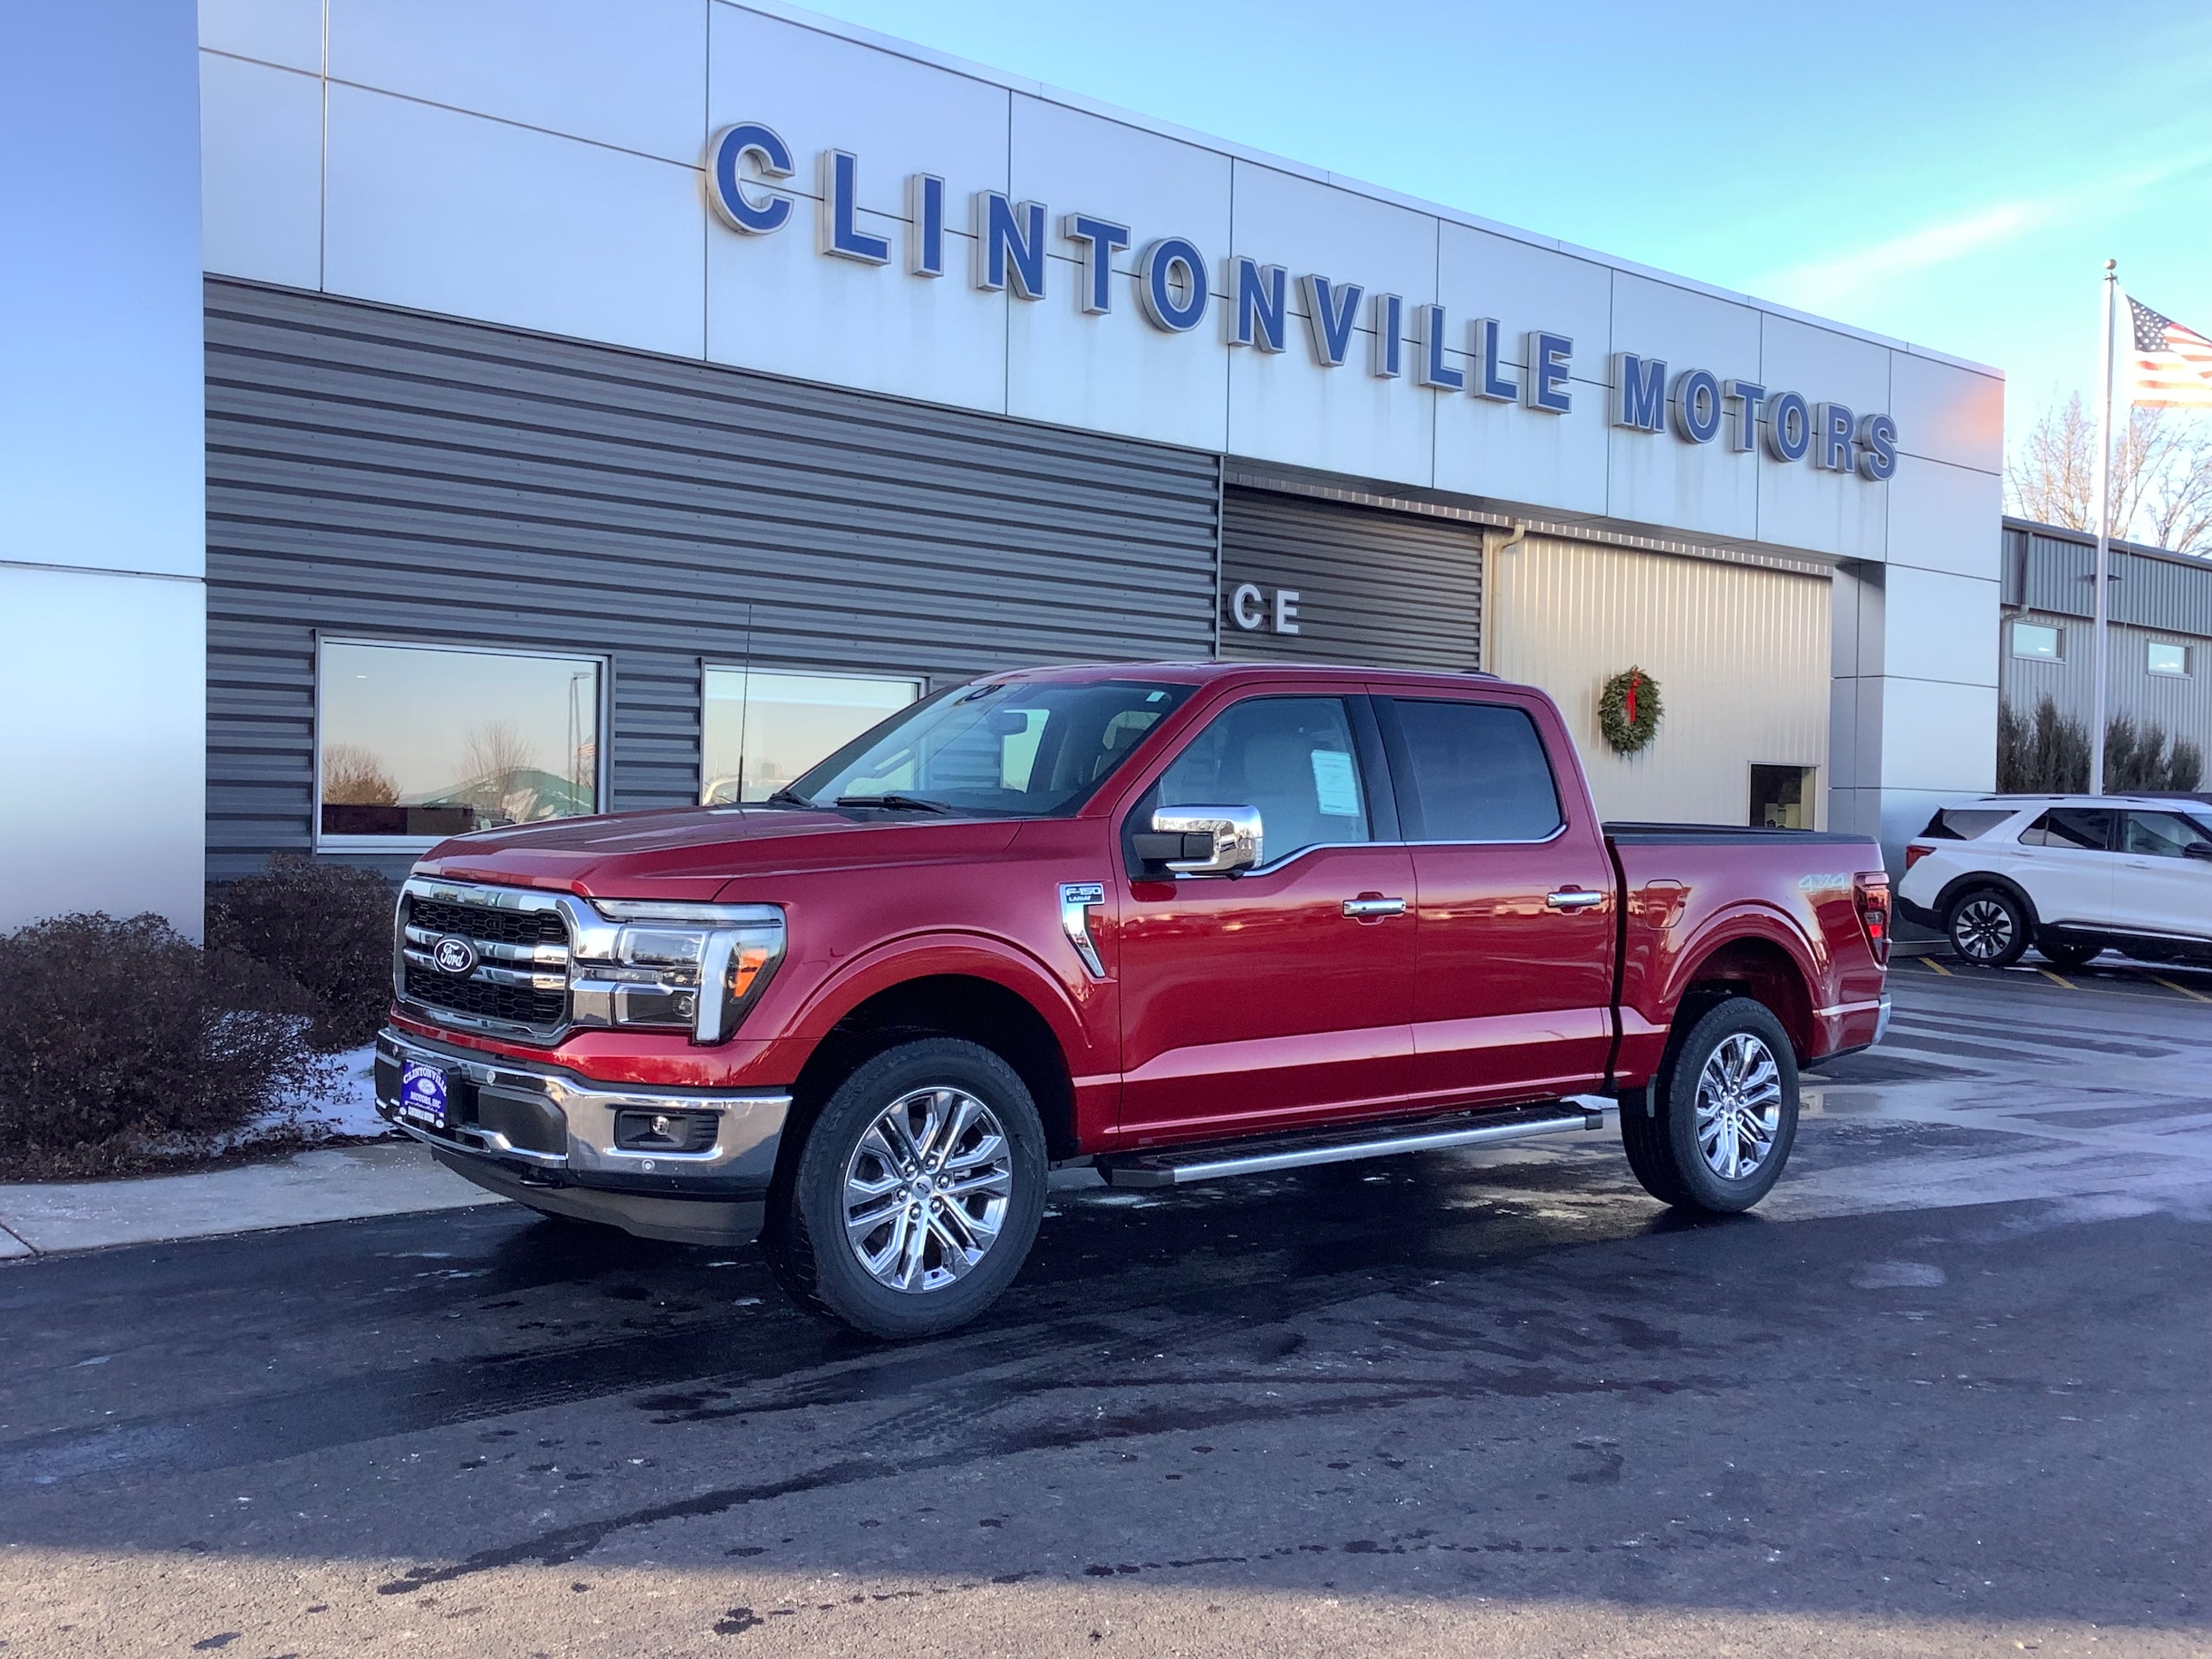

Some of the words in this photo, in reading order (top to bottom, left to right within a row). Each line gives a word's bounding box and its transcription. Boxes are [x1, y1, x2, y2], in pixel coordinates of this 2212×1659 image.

[707, 121, 1573, 414] CLINTONVILLE
[1613, 352, 1898, 481] MOTORS
[441, 942, 465, 967] Ford
